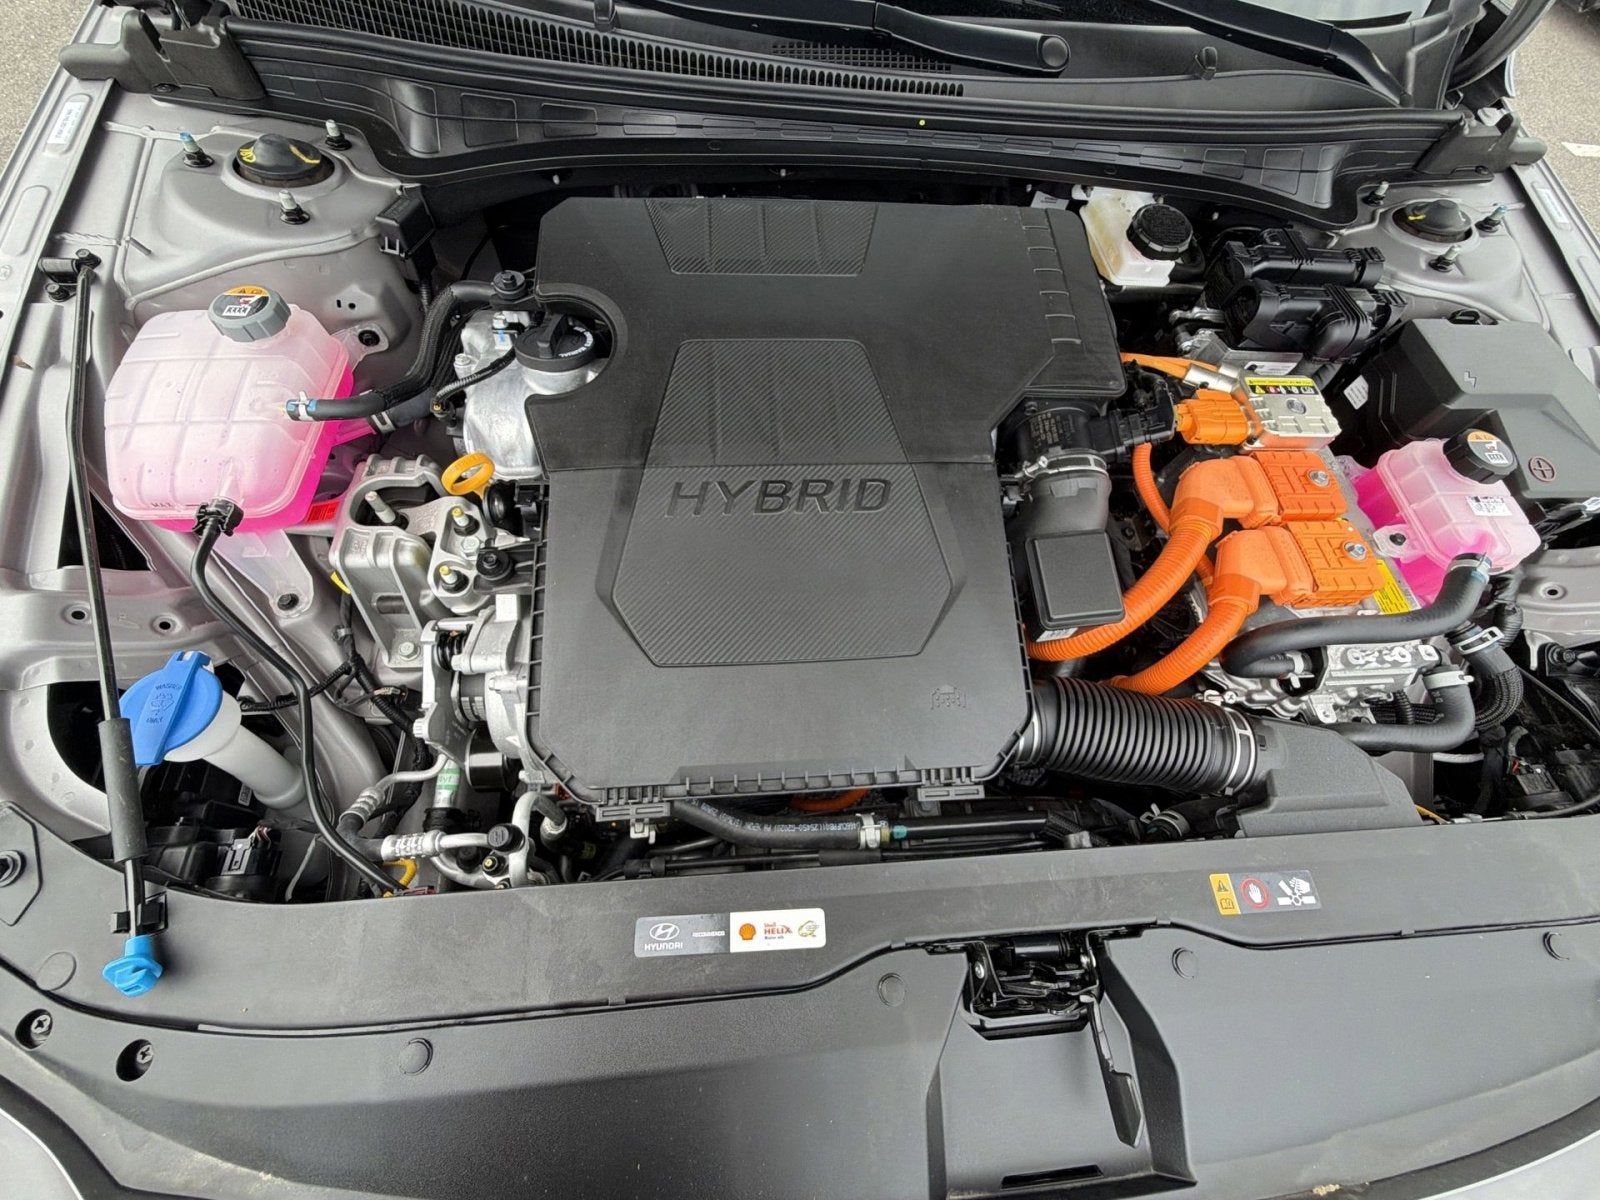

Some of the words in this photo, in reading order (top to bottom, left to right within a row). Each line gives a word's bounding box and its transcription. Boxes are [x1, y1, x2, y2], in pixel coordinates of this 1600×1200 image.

[664, 478, 892, 518] HYBRID
[764, 926, 792, 935] HELIX
[644, 942, 683, 951] HYUNDAI
